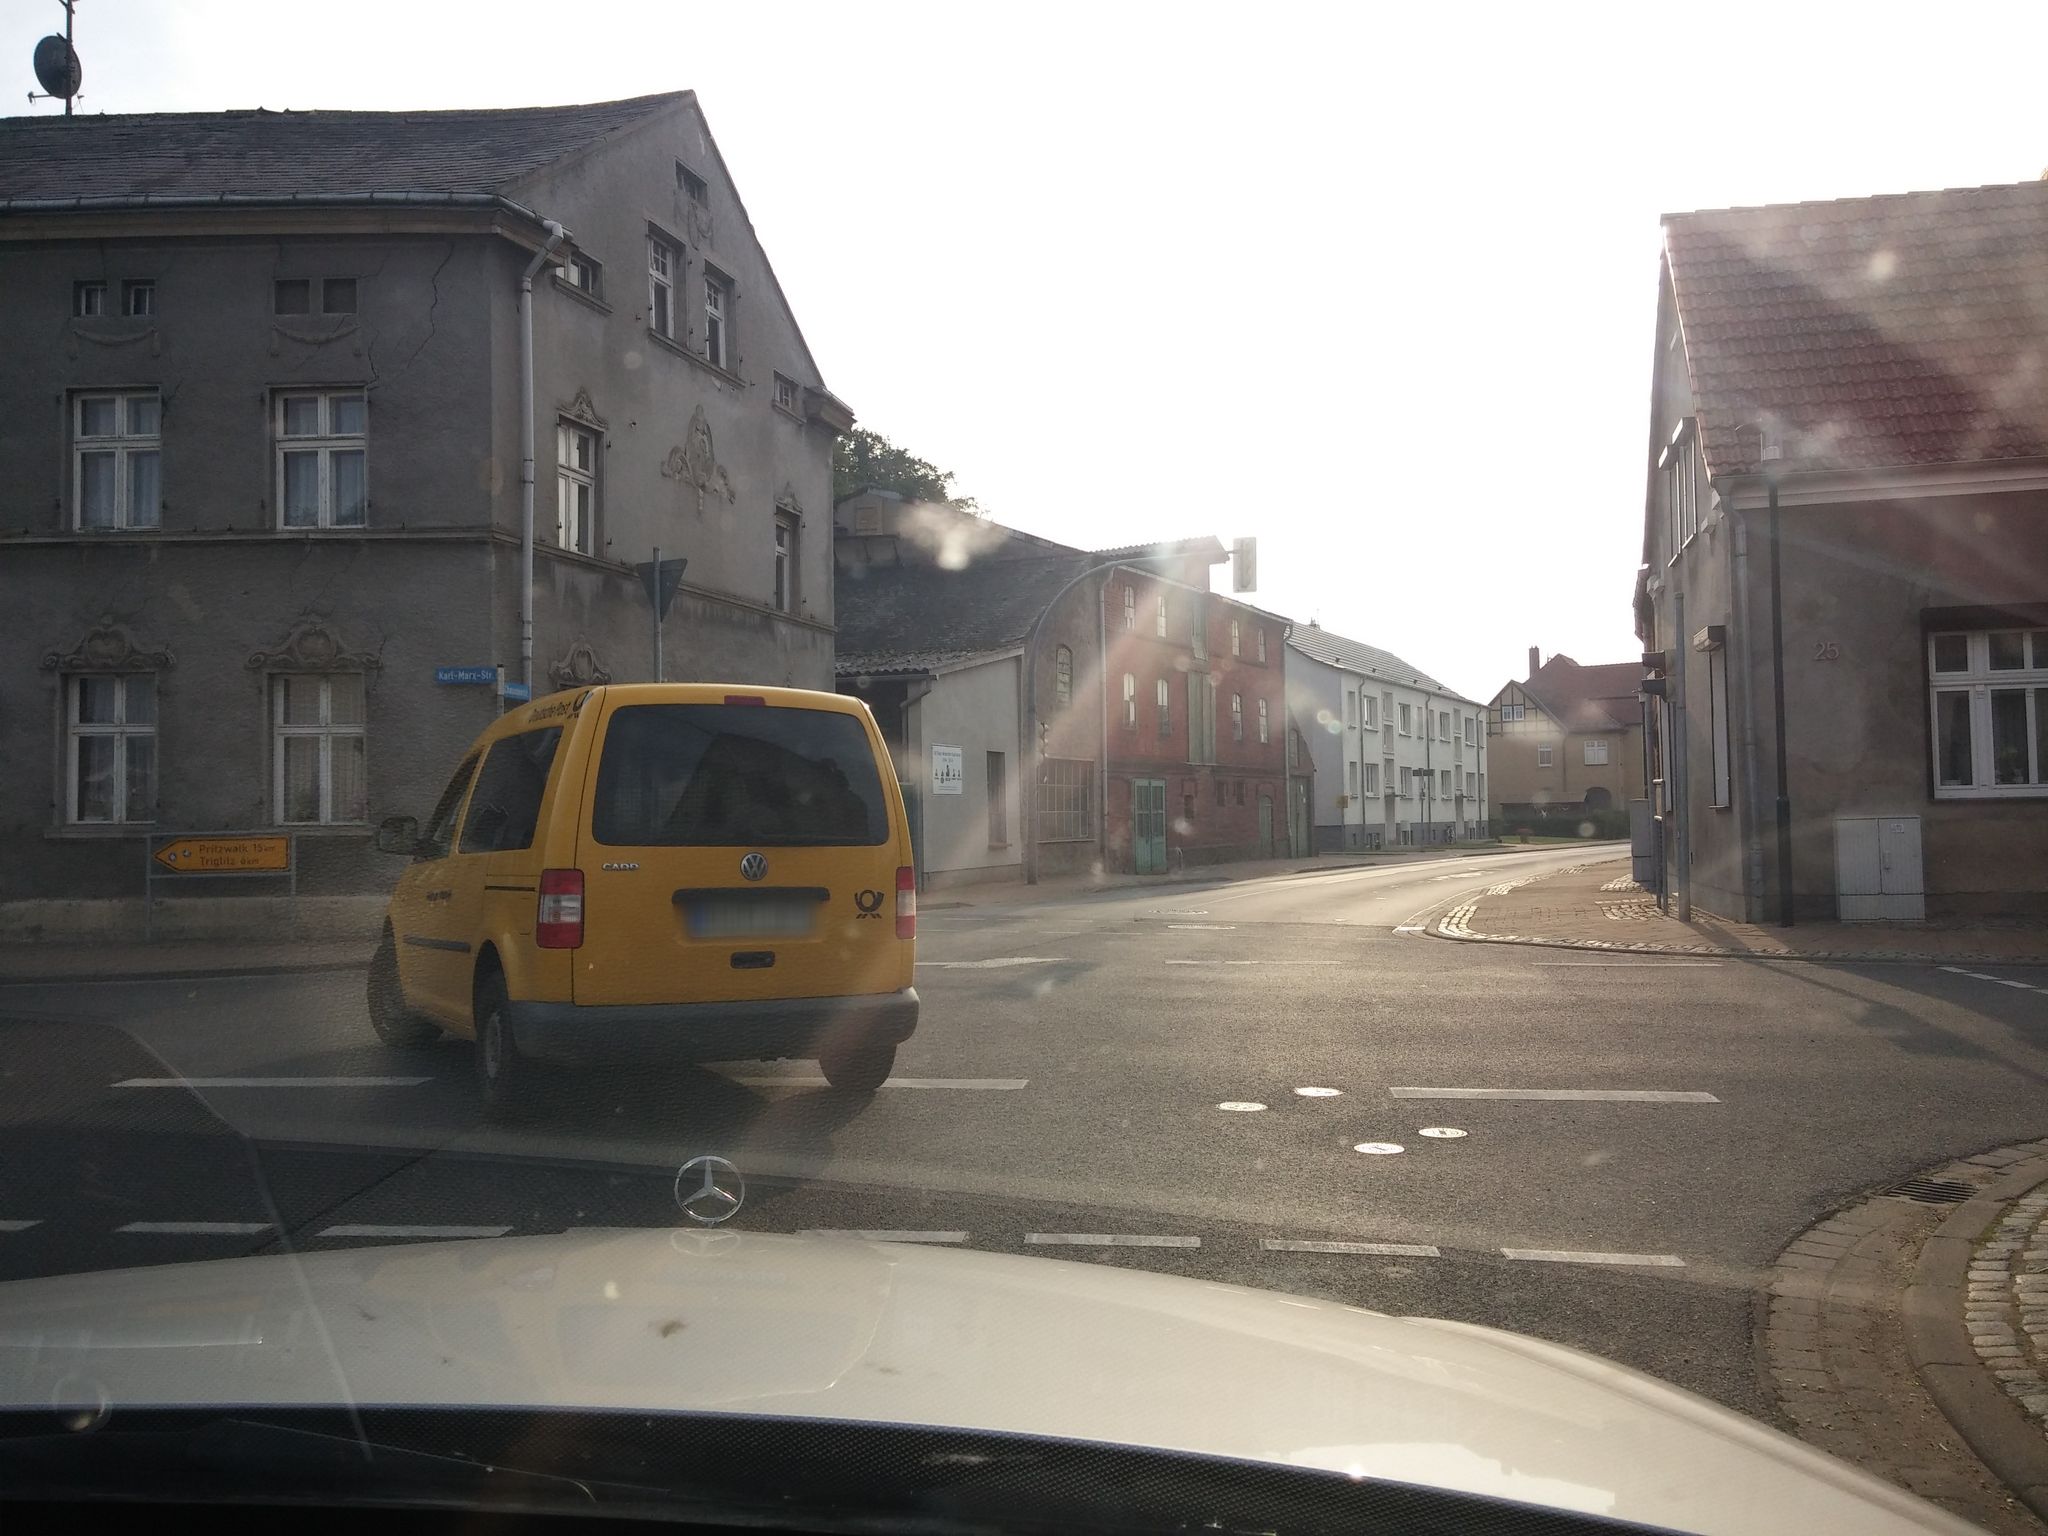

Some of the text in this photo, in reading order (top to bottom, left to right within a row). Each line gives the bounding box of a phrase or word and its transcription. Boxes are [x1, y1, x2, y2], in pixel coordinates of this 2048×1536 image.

[1813, 641, 1840, 660] 25
[438, 670, 495, 681] Karl-Marx-Str.
[199, 843, 248, 854] Pritzwalk
[200, 856, 235, 865] Triglitz
